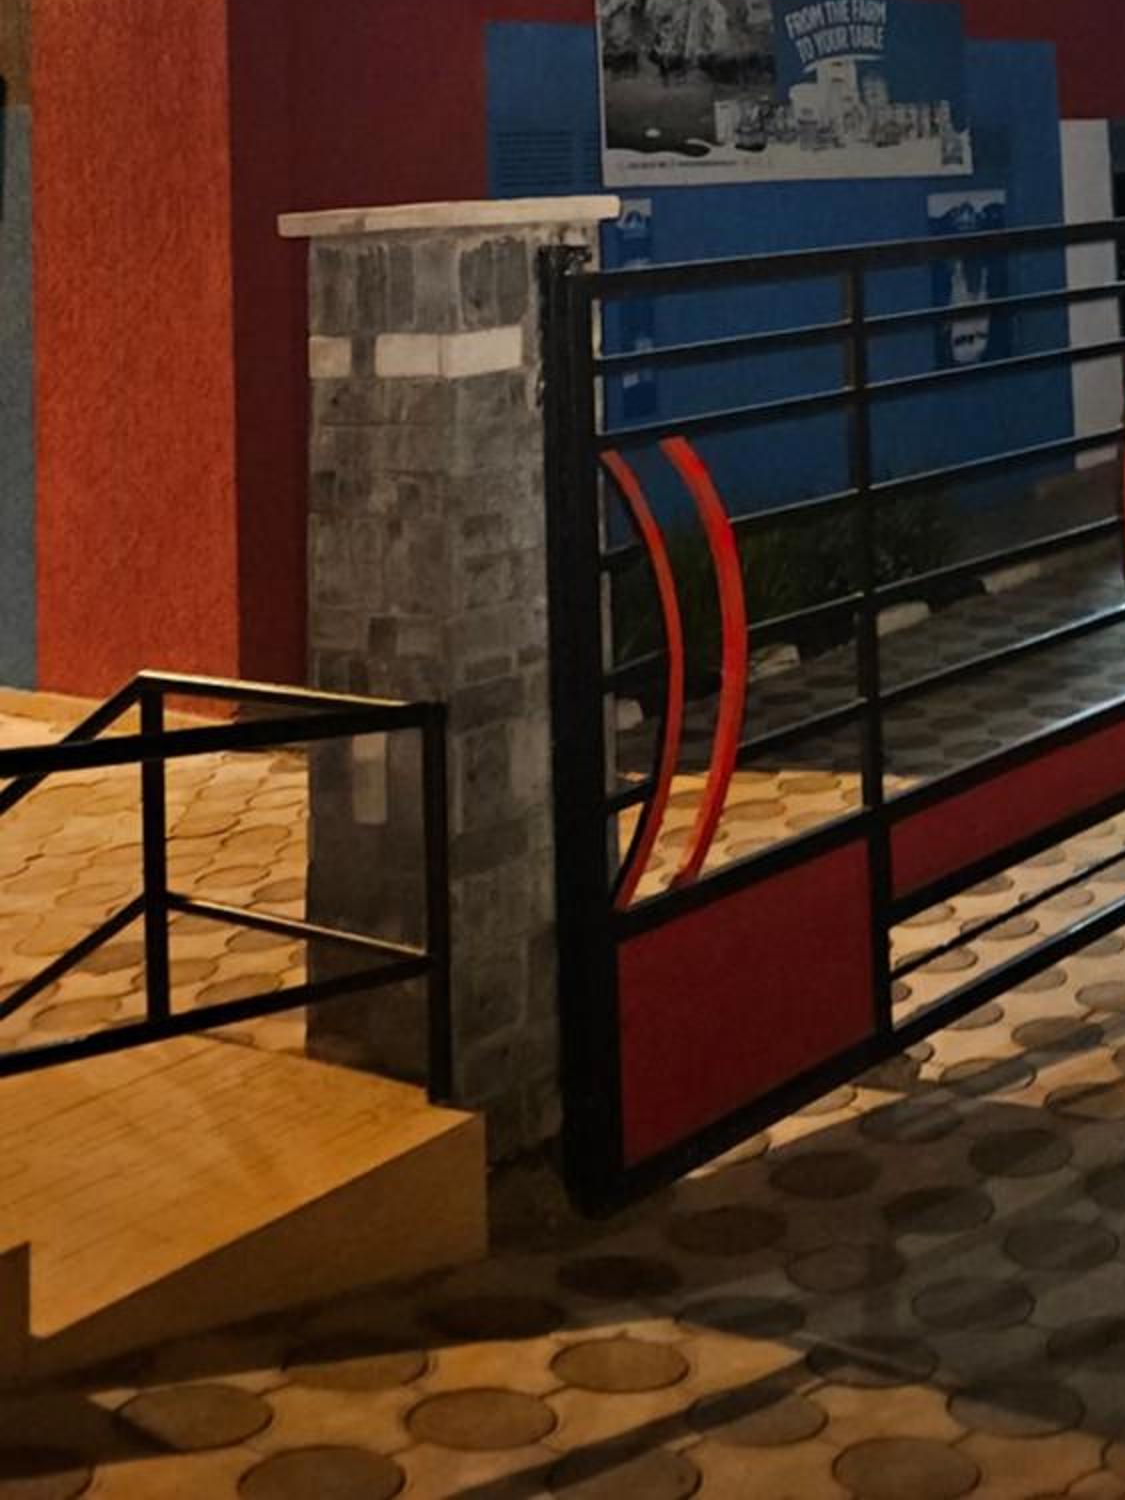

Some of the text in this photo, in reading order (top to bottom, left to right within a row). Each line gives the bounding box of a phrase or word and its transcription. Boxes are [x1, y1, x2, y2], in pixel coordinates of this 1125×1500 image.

[785, 3, 825, 39] FROM
[824, 0, 850, 23] THE
[795, 25, 883, 63] TO YOUR TABLE
